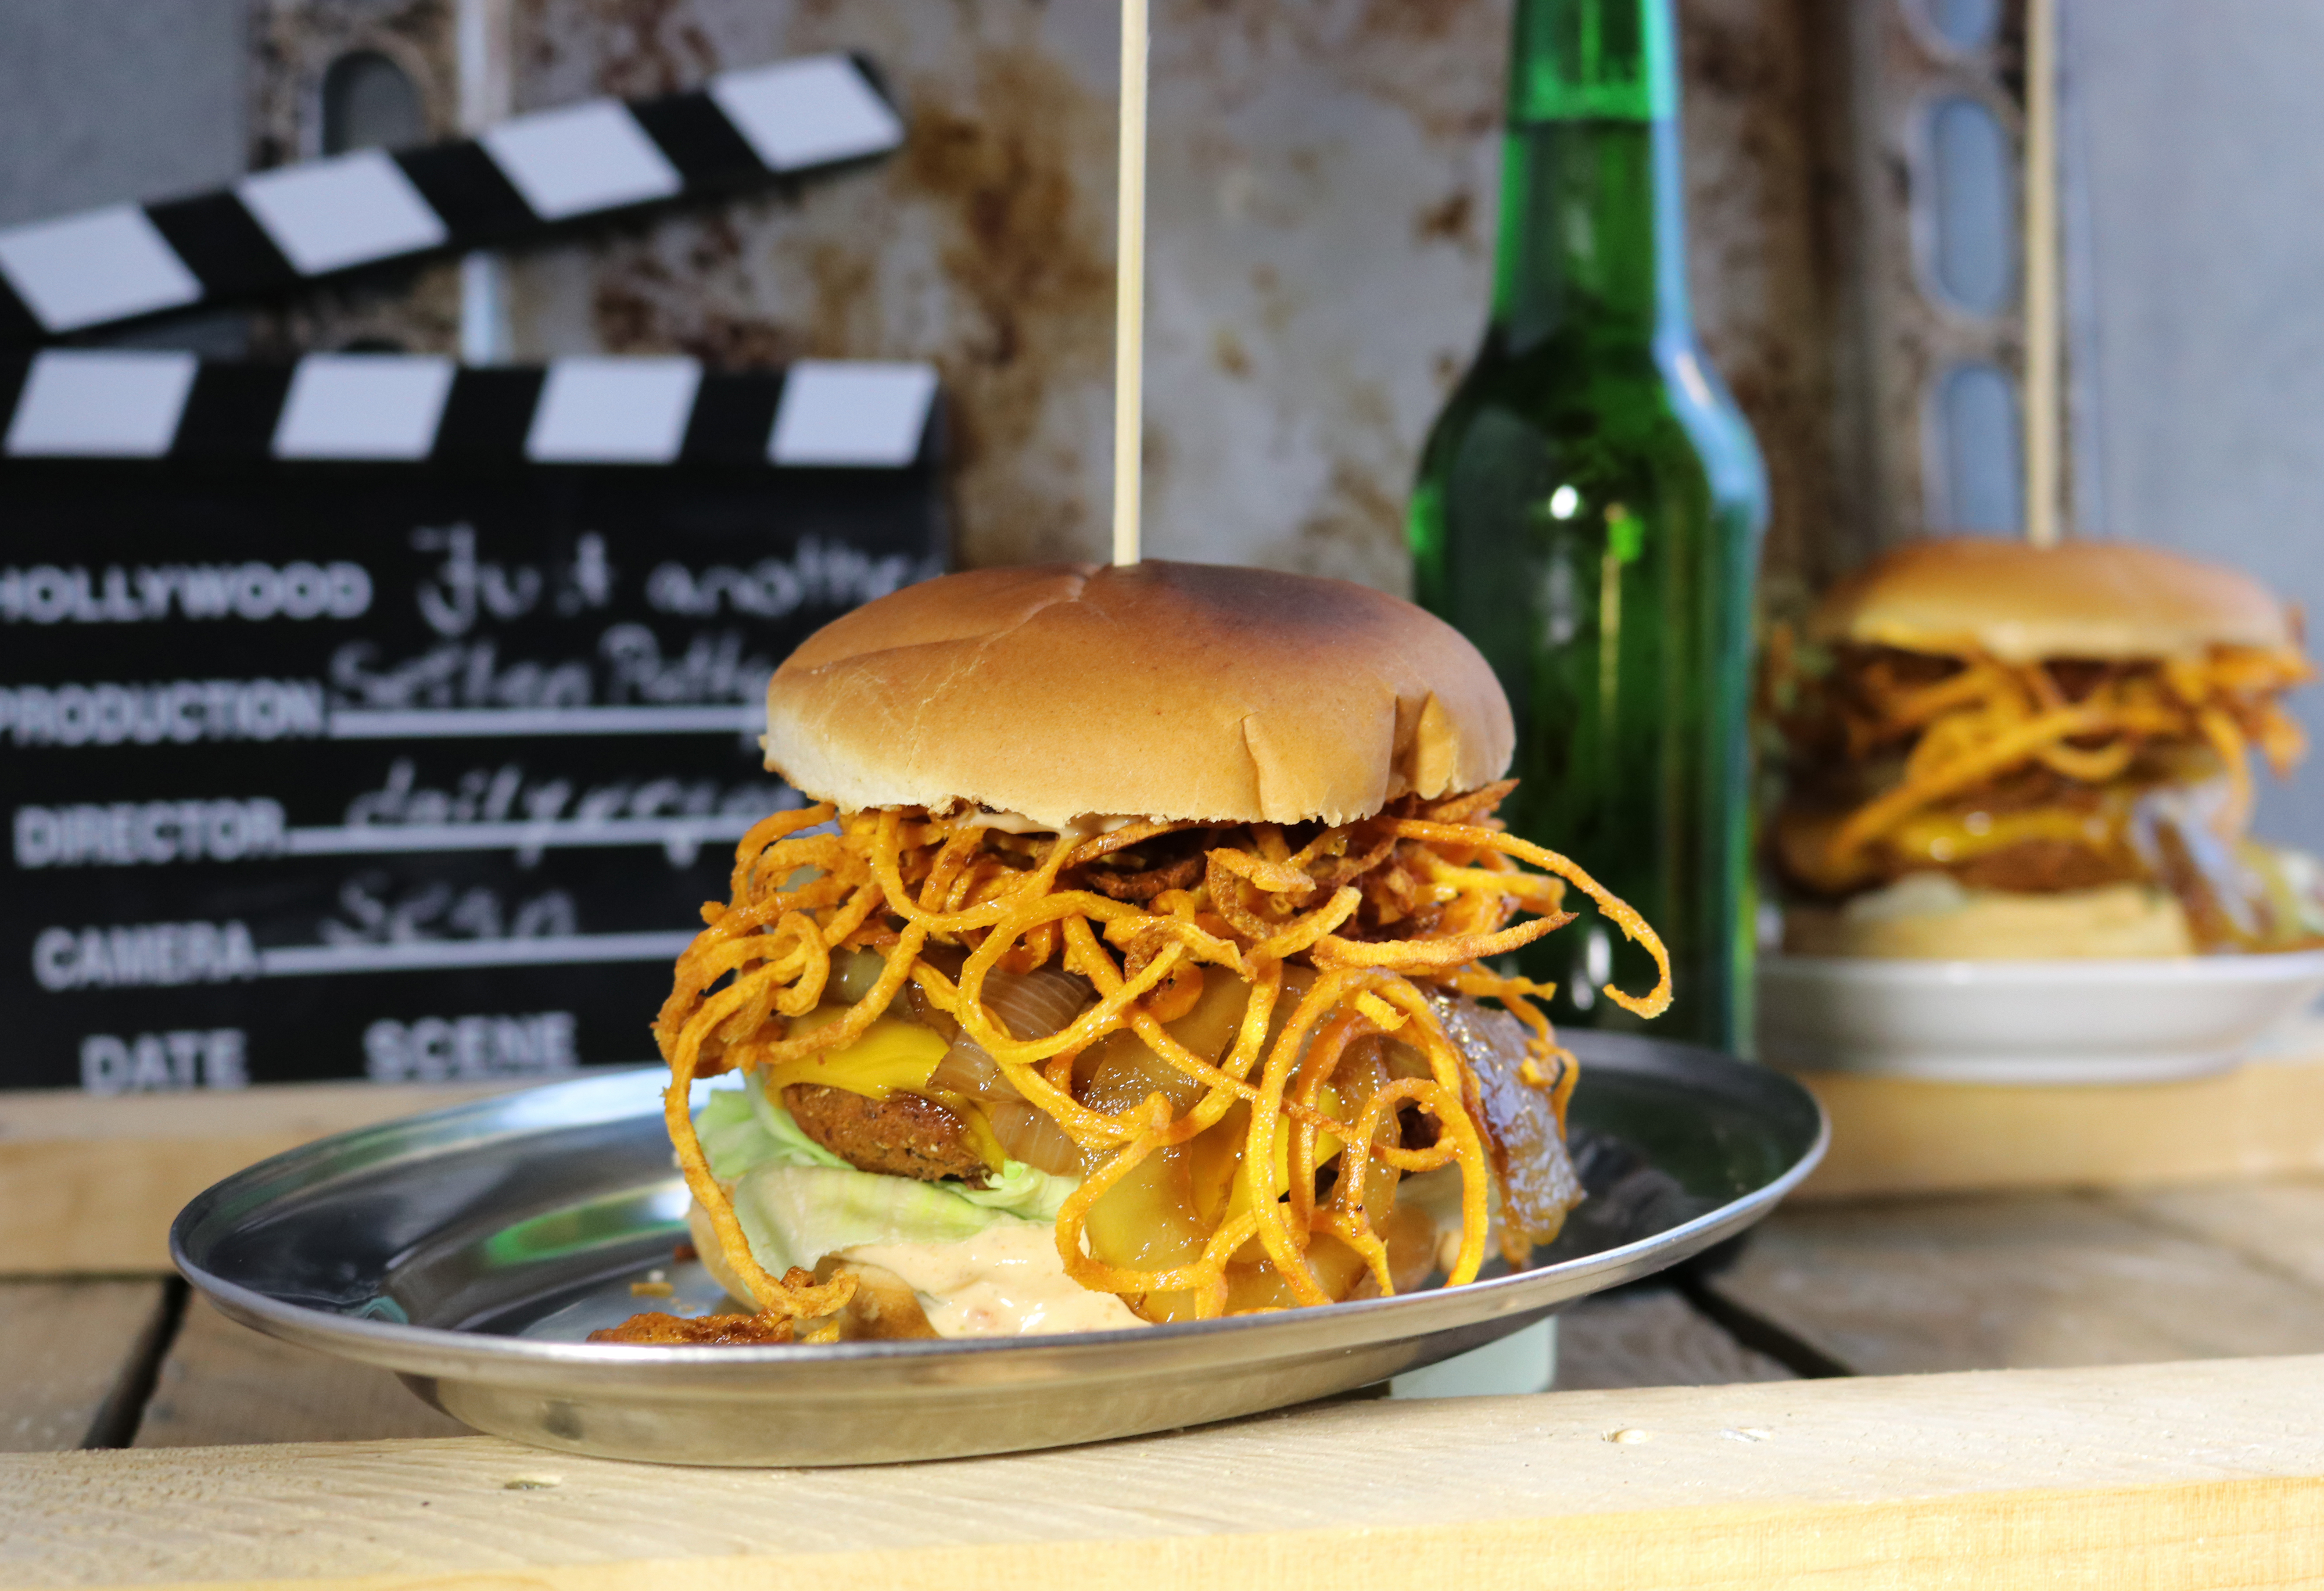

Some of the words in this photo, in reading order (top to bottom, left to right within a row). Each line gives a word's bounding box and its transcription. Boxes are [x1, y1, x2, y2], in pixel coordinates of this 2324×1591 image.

[14, 796, 287, 868] DIRECTOR
[33, 919, 259, 991] CAMERA
[80, 1028, 249, 1094] DATE
[363, 1011, 578, 1080] SCENE
